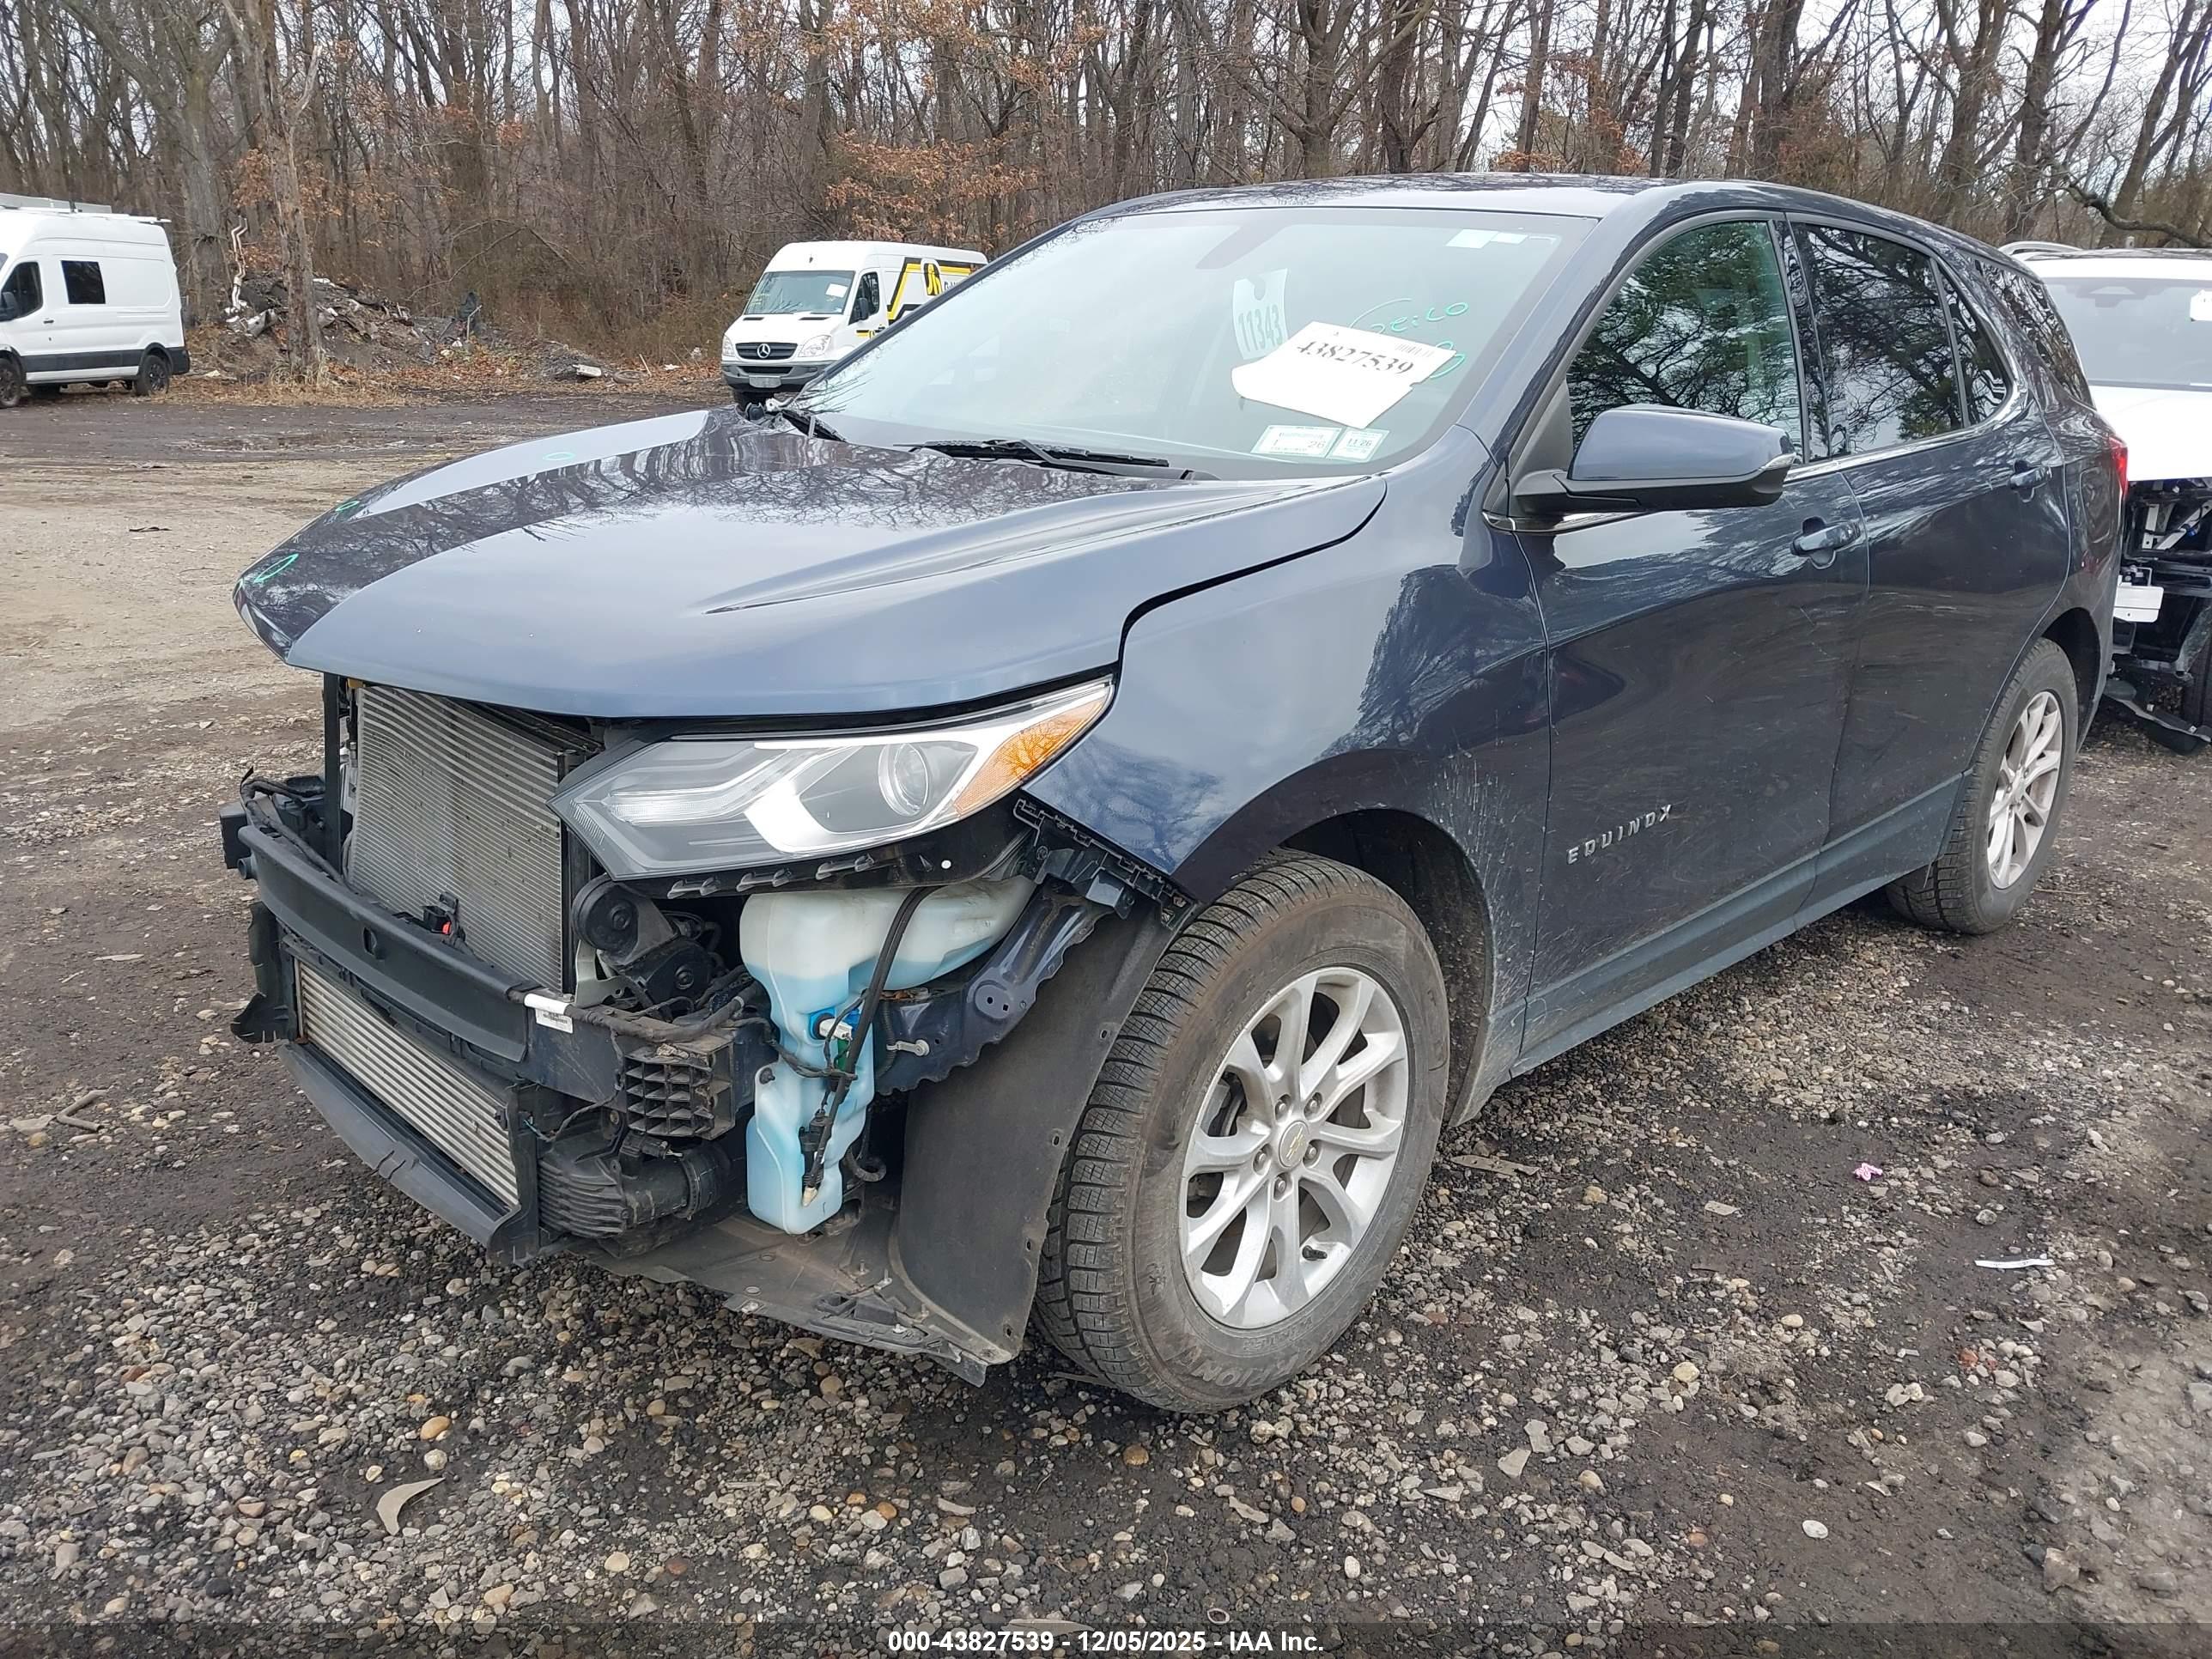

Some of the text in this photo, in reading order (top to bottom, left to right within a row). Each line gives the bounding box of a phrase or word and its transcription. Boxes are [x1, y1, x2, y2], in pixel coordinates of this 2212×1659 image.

[1237, 303, 1284, 352] 11343
[1297, 341, 1415, 374] 43827539
[1566, 804, 1673, 865] EQUINOX
